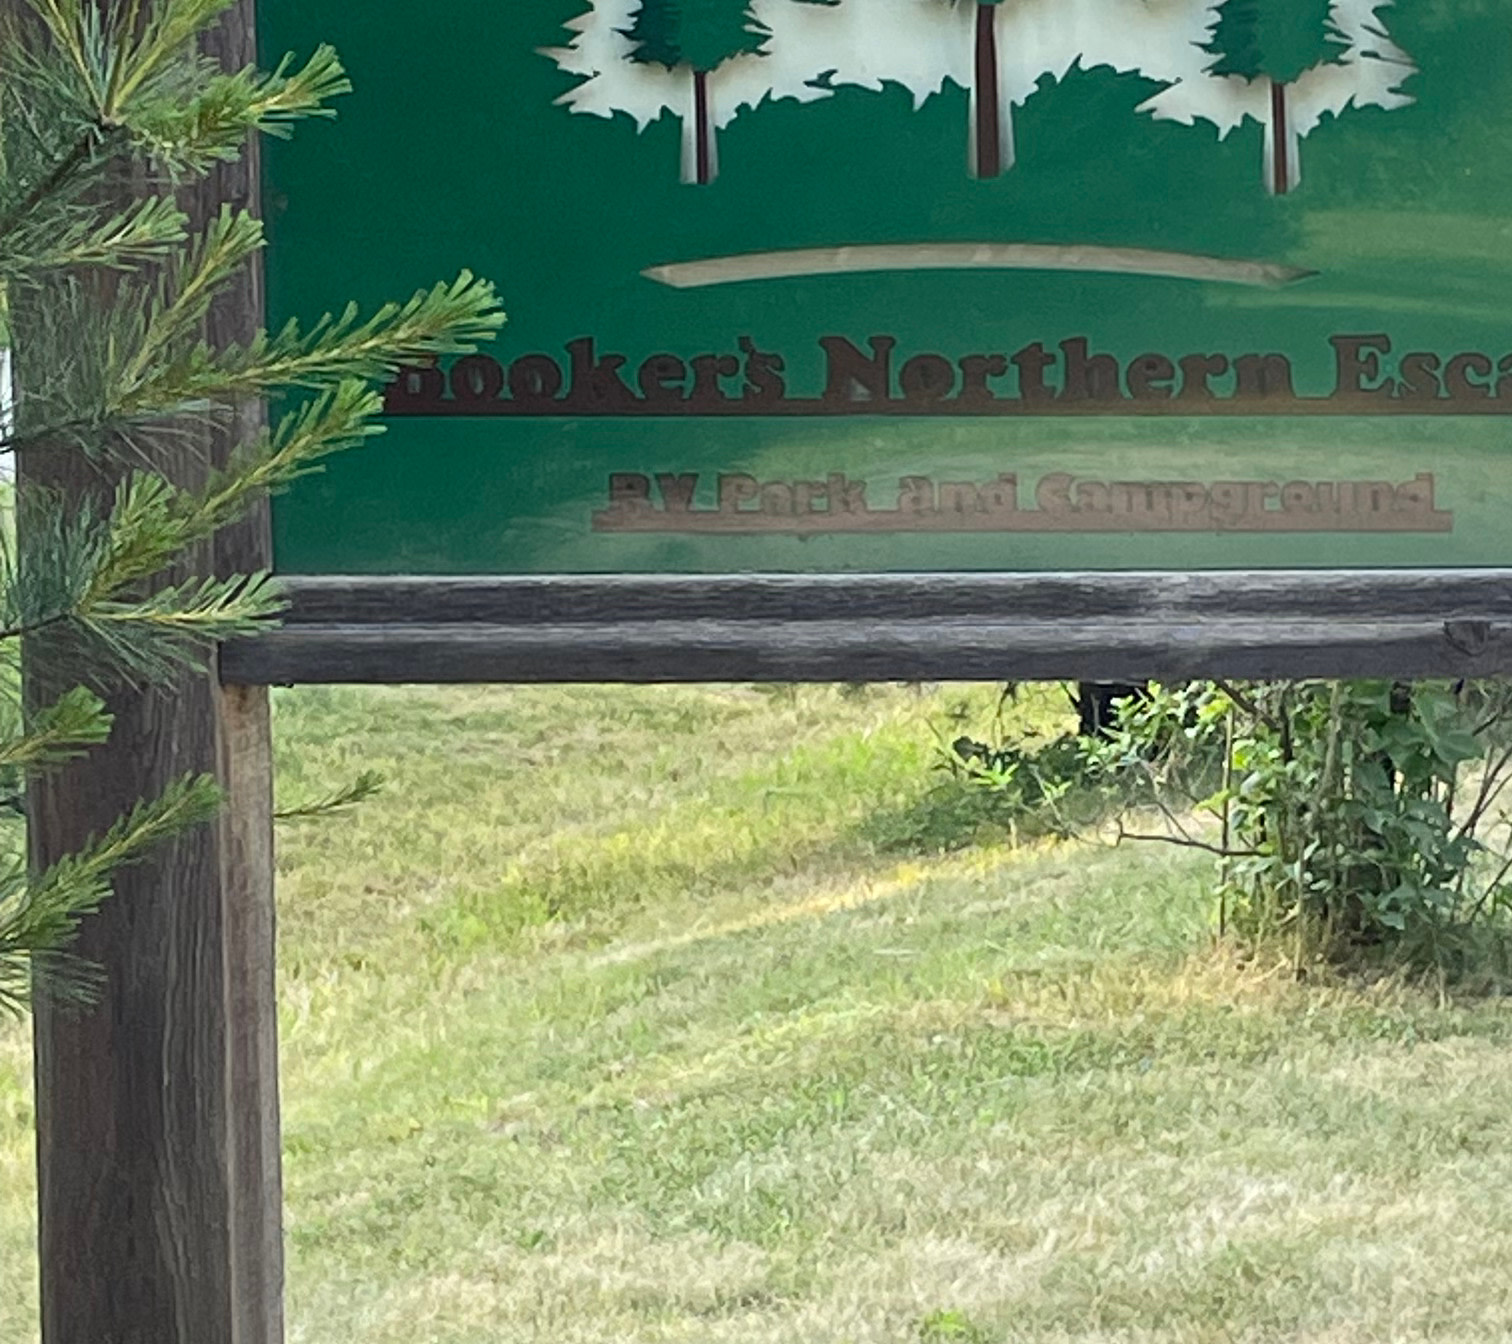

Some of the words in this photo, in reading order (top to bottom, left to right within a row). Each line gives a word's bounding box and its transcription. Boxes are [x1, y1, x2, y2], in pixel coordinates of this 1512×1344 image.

[819, 334, 1299, 408] Northern
[608, 472, 699, 512] RV
[716, 472, 868, 514] Park
[898, 472, 1018, 514] and
[1034, 471, 1435, 526] Campground
